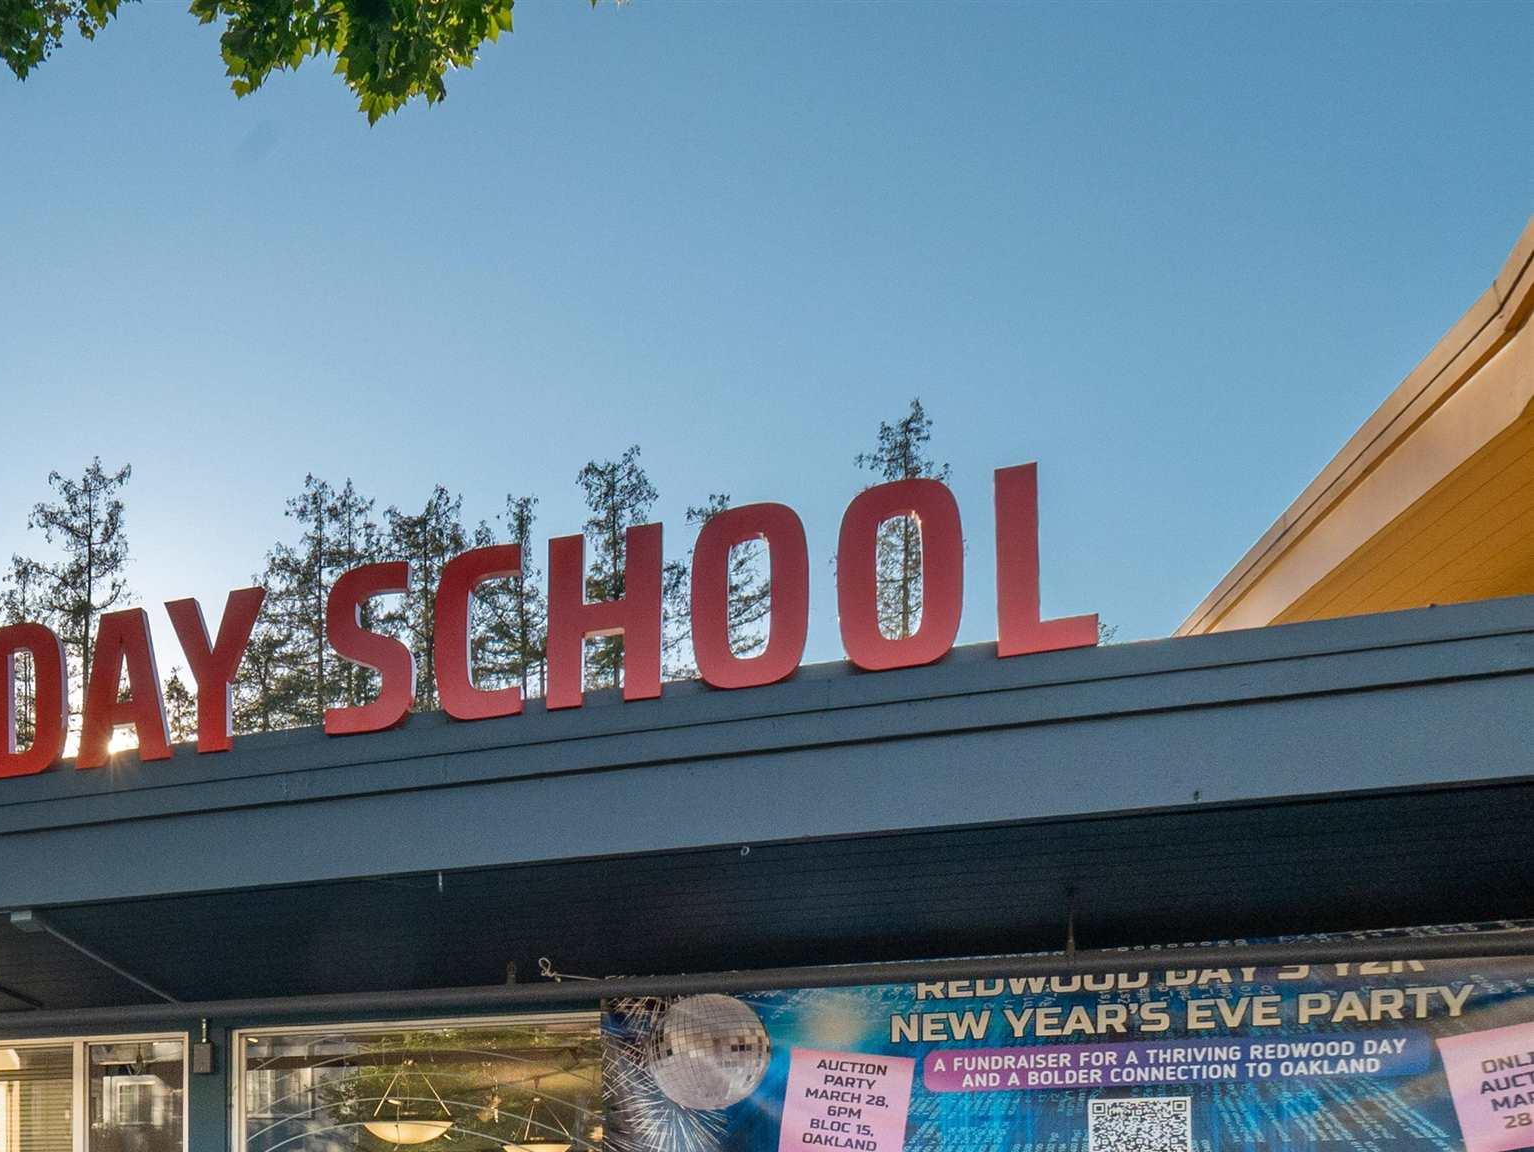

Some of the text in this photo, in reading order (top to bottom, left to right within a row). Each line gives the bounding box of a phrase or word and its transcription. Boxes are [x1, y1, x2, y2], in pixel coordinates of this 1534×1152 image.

[325, 462, 1100, 736] SCHOOL
[917, 972, 1149, 1000] REDWOOD
[1165, 963, 1310, 987] DAY
[890, 984, 1475, 1043] NEW YEAR'S EVE PARTY
[933, 1038, 1407, 1072] A FUNDRAISER FOR A THRIVING REDWOOD DAY
[816, 1059, 888, 1076] AUCTION
[961, 1058, 1381, 1088] AND A BOLDER CONNECTION TO OAKLAND
[824, 1074, 876, 1090] PARTY
[805, 1087, 862, 1104] MARCH
[827, 1105, 862, 1120] 6PM
[809, 1118, 851, 1133] BLOC
[802, 1132, 877, 1152] OAKLAND
